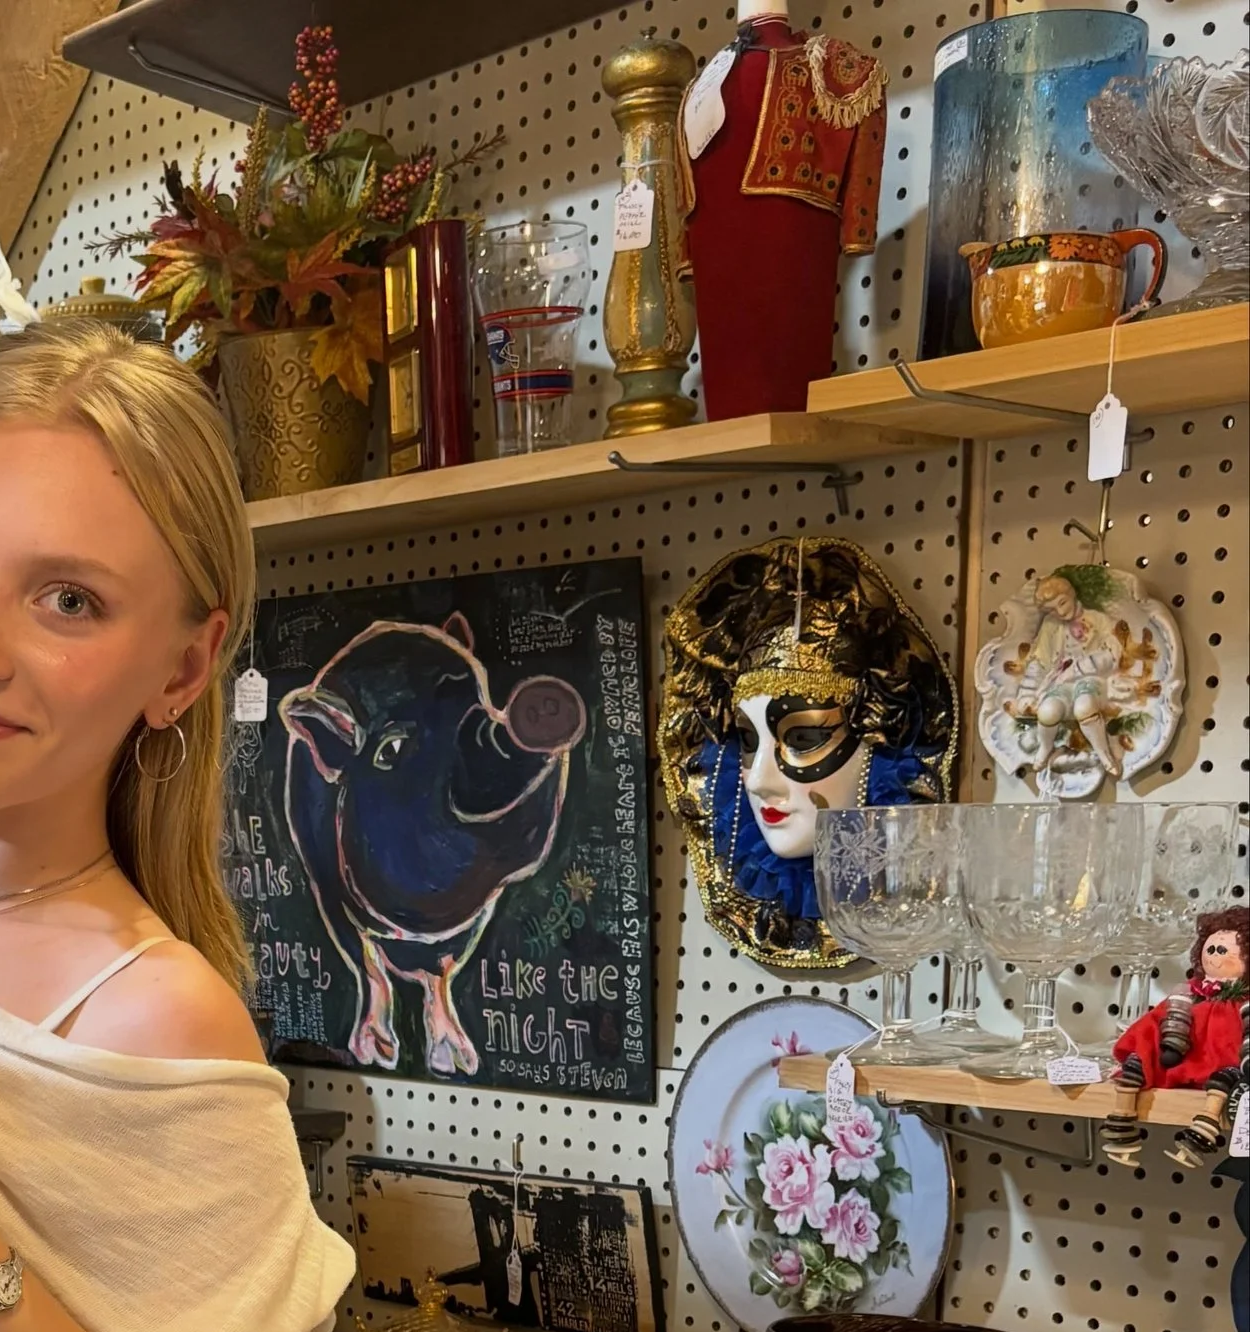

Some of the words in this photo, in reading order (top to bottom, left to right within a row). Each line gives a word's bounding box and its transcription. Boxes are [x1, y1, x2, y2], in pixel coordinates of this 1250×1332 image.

[252, 905, 280, 934] in
[587, 1276, 606, 1293] 14
[557, 1300, 576, 1318] 42
